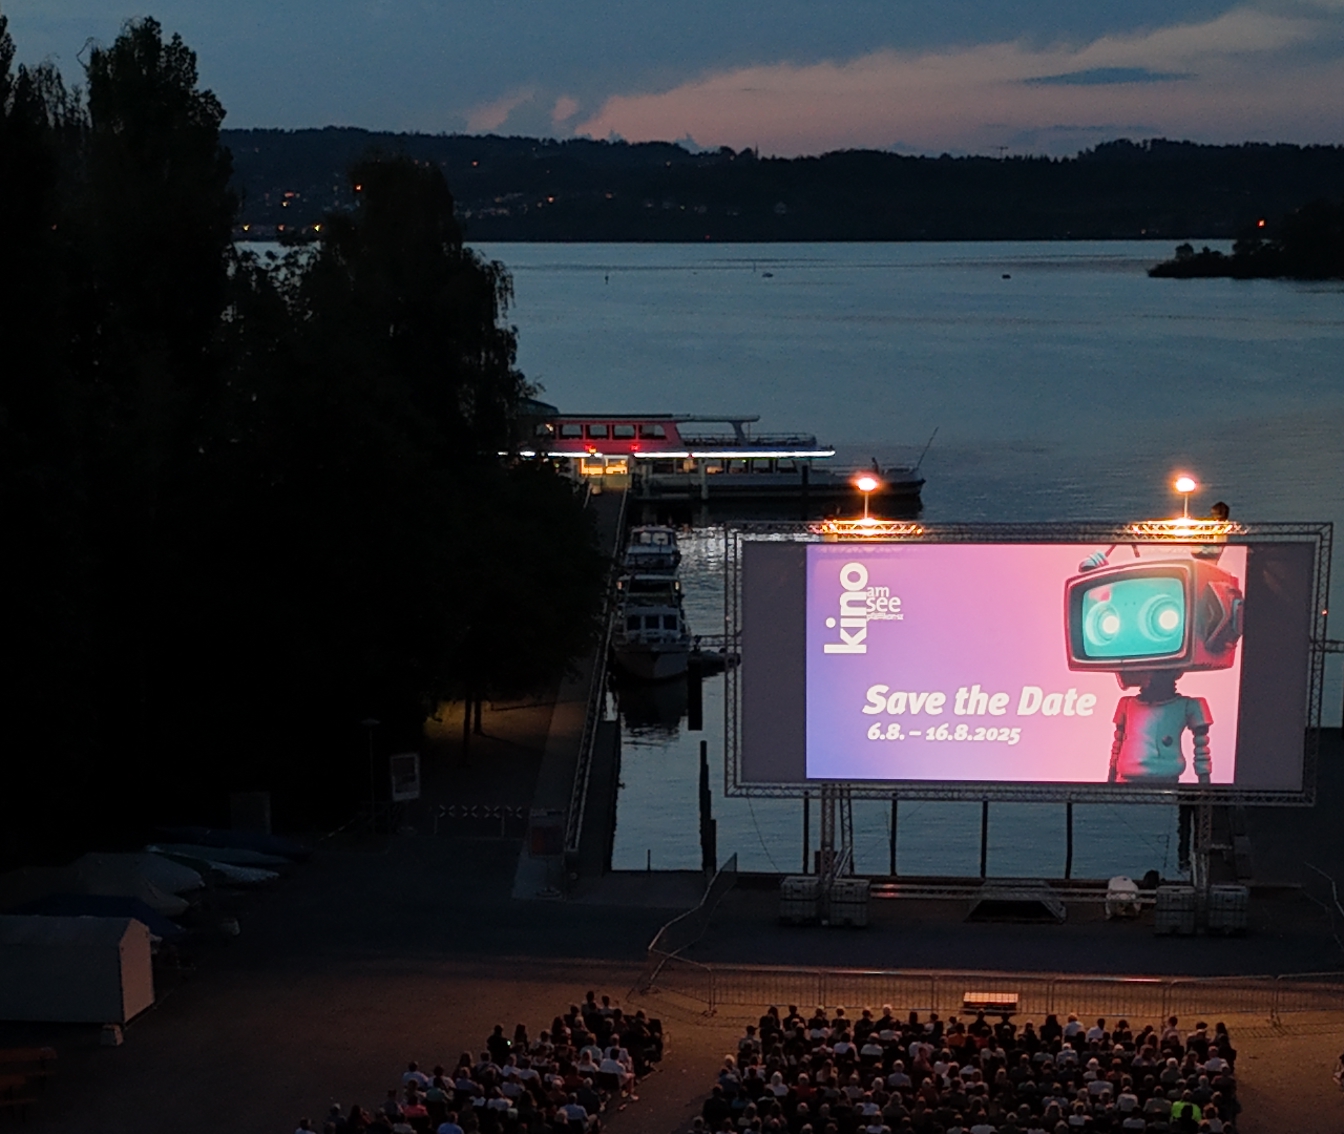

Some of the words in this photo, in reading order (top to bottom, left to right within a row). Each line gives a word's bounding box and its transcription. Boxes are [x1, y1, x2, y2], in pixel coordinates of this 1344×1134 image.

[867, 586, 890, 598] am
[823, 562, 868, 653] kino
[866, 596, 902, 613] see
[862, 684, 946, 716] Save
[954, 684, 1010, 716] the
[1017, 686, 1097, 717] Date
[867, 722, 905, 741] 6.8.
[925, 723, 1022, 746] 16.8.2025
